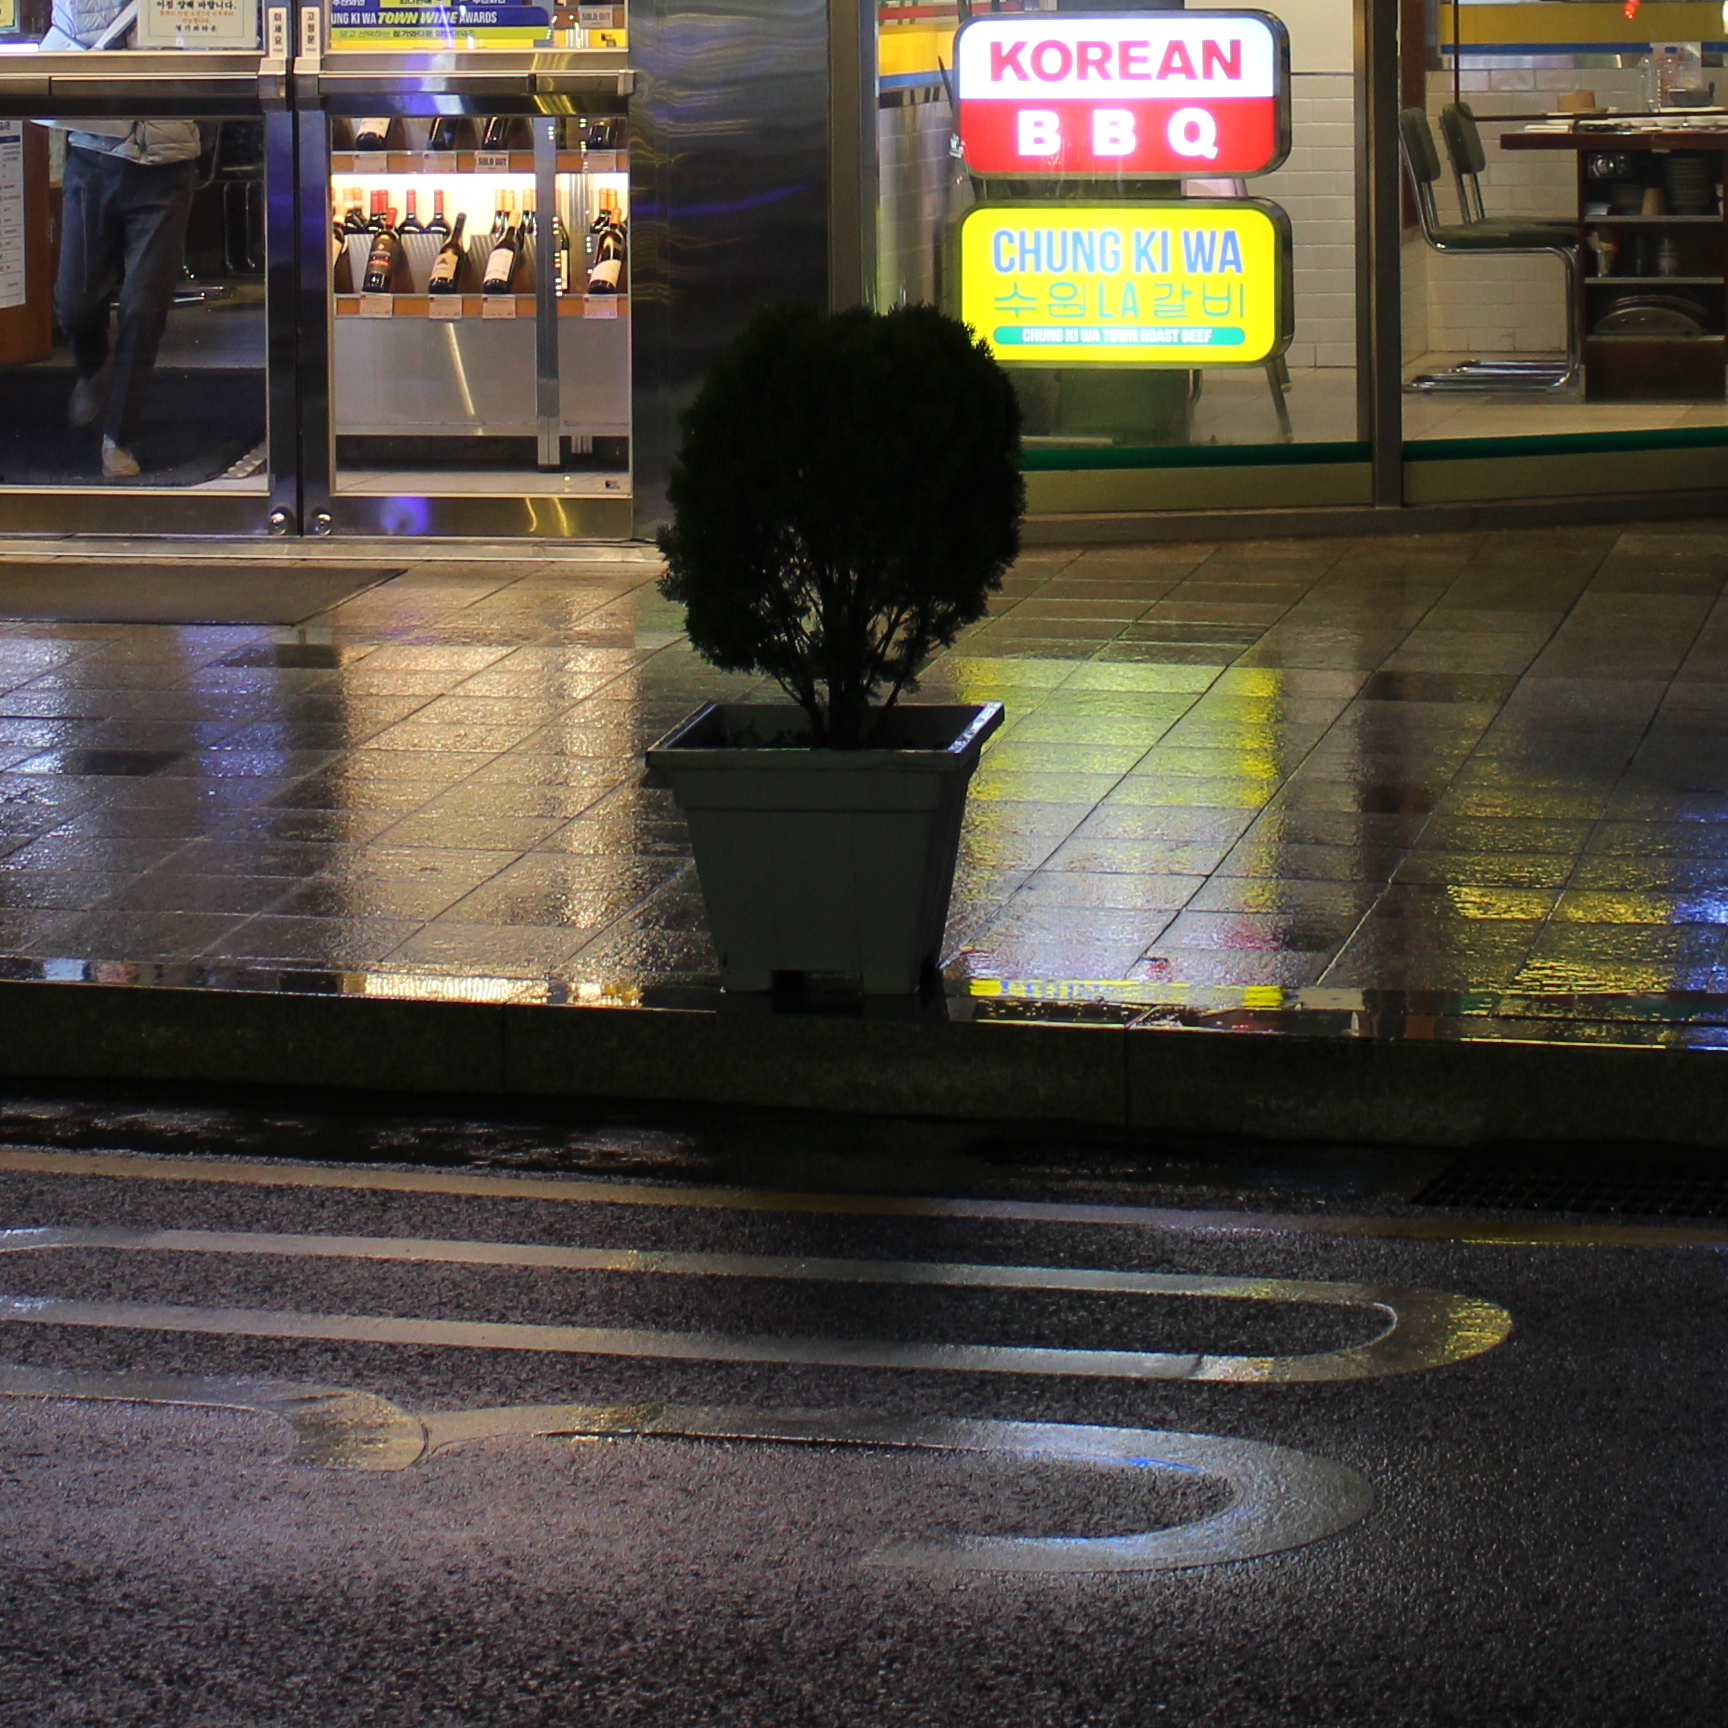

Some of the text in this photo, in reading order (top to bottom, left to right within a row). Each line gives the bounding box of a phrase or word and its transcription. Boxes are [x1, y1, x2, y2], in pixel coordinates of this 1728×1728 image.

[350, 12, 361, 25] KI
[362, 12, 377, 24] WA
[377, 12, 419, 25] TOWN
[459, 11, 498, 24] AWARDS
[990, 39, 1241, 82] KOREAN
[1017, 107, 1218, 159] BBQ
[478, 158, 507, 166] SOLD OUT
[993, 229, 1243, 273] CHUNG KI WA
[1022, 328, 1066, 342] CHUNG
[1068, 328, 1079, 342] KI
[1080, 328, 1100, 342] WA
[1139, 328, 1180, 342] ROAST
[1181, 328, 1213, 342] BEEF
